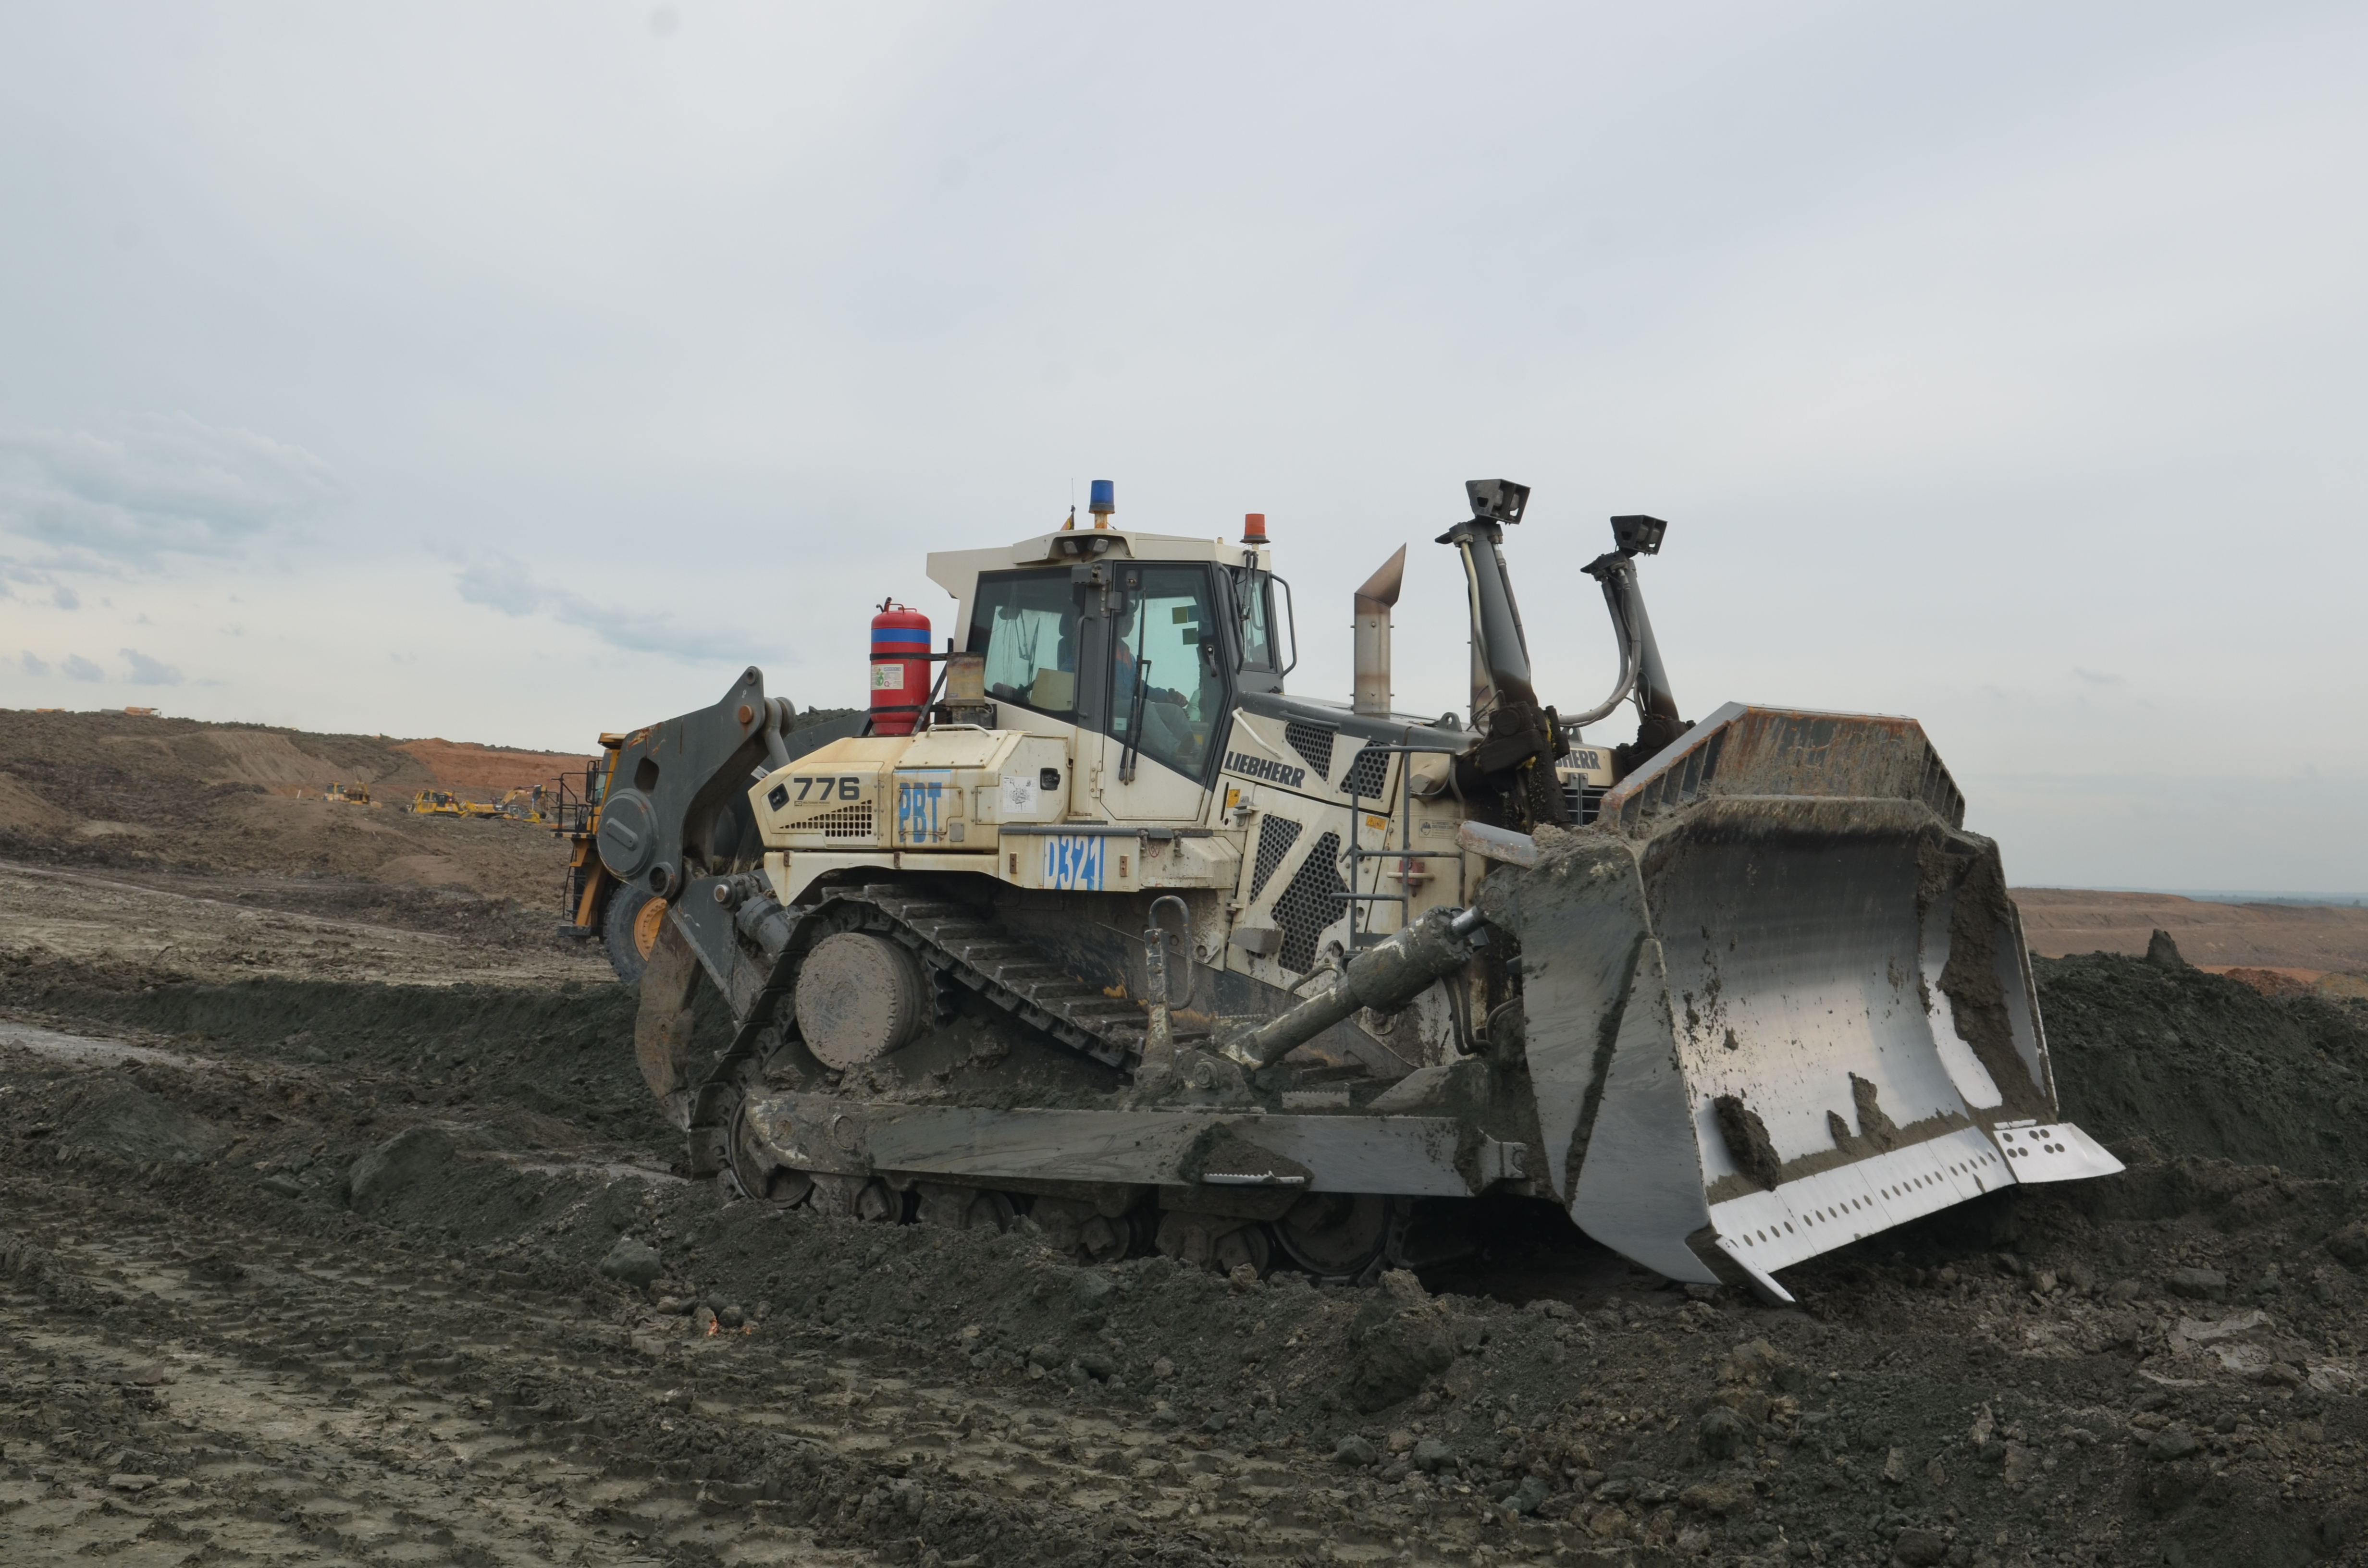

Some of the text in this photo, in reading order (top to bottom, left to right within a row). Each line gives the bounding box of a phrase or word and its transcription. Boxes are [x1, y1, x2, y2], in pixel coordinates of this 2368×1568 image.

[794, 777, 859, 800] 776
[1224, 751, 1306, 788] LIEBHERR
[899, 782, 942, 843] PBT
[1044, 835, 1100, 891] D321
